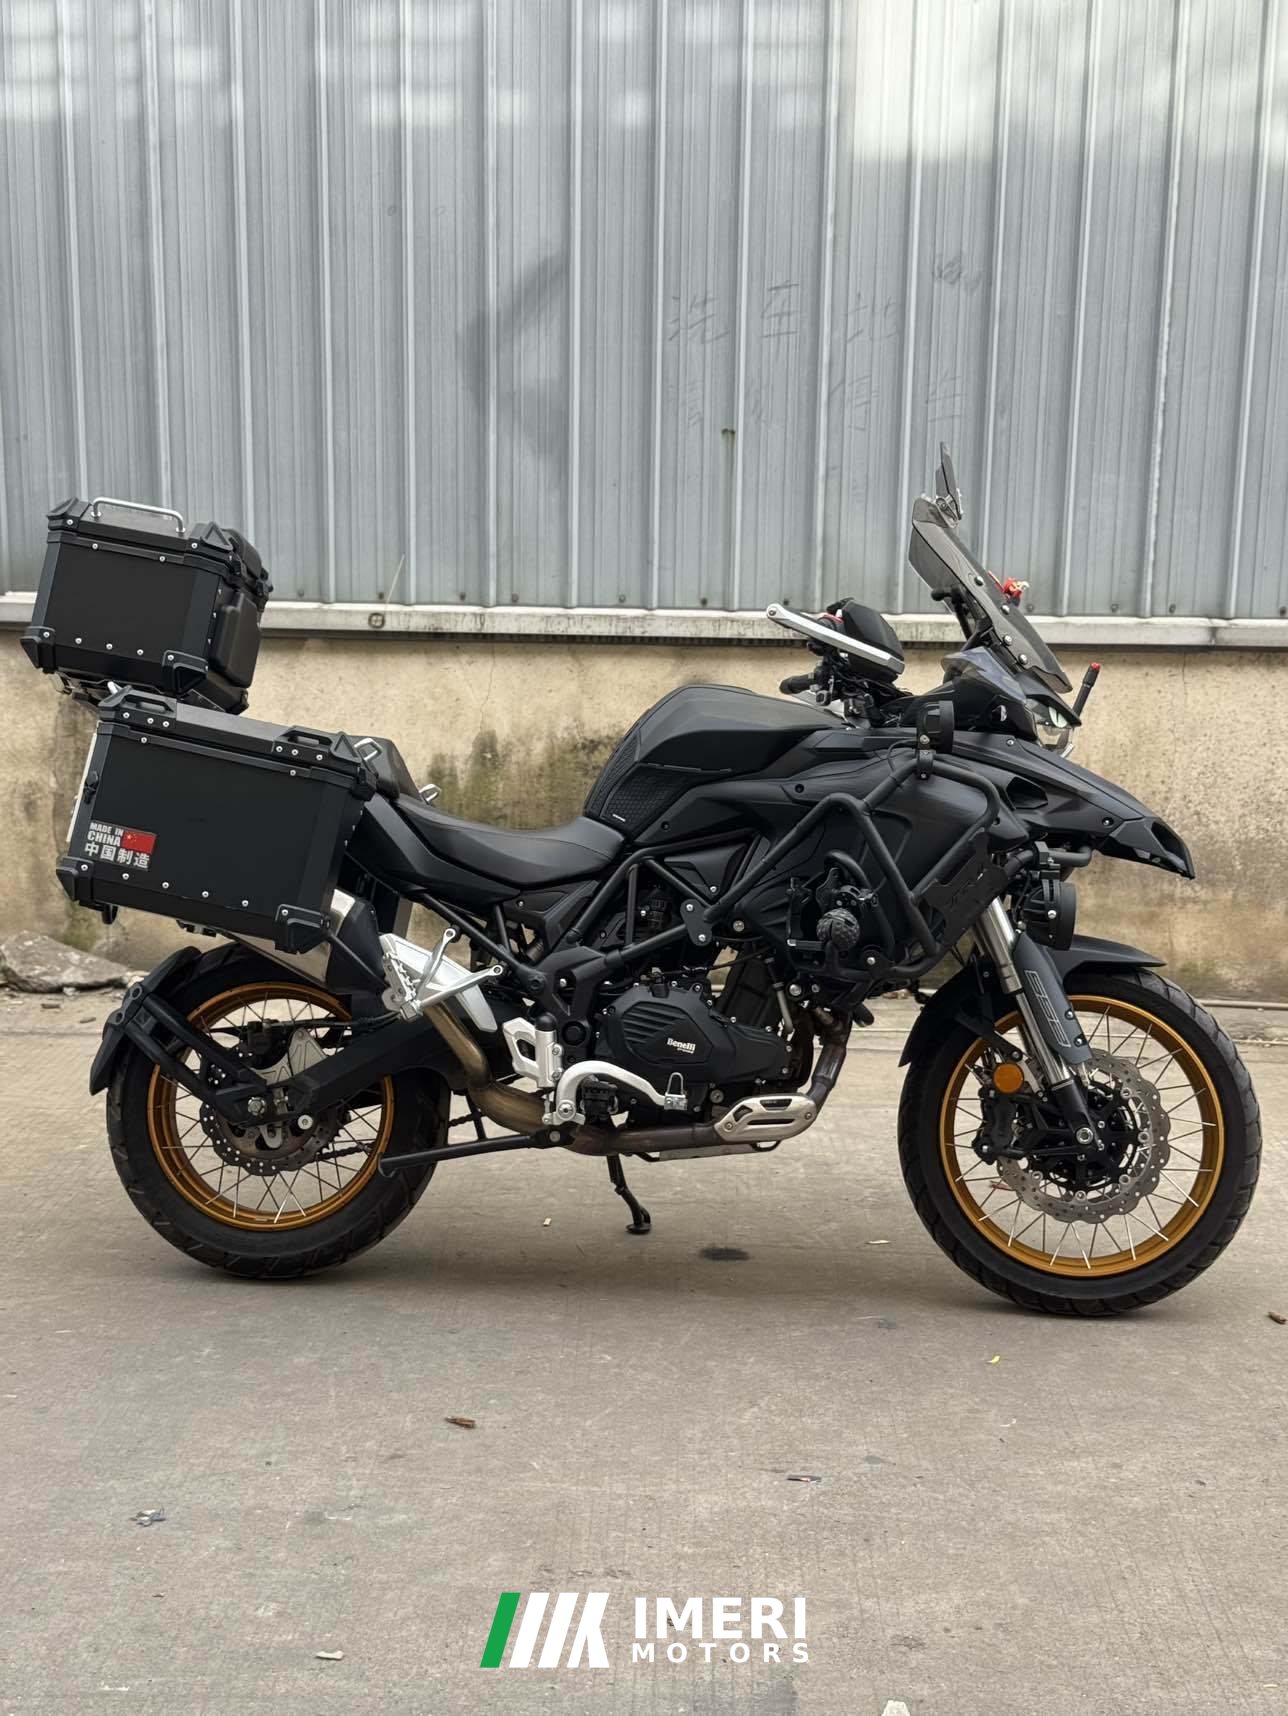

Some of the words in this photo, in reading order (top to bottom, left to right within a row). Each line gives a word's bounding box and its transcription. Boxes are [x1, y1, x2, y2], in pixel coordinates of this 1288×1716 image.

[90, 823, 111, 834] MADE
[115, 828, 124, 837] IN
[87, 831, 121, 847] CHINA
[85, 842, 150, 869] 中国制造
[667, 1037, 696, 1051] Benelli
